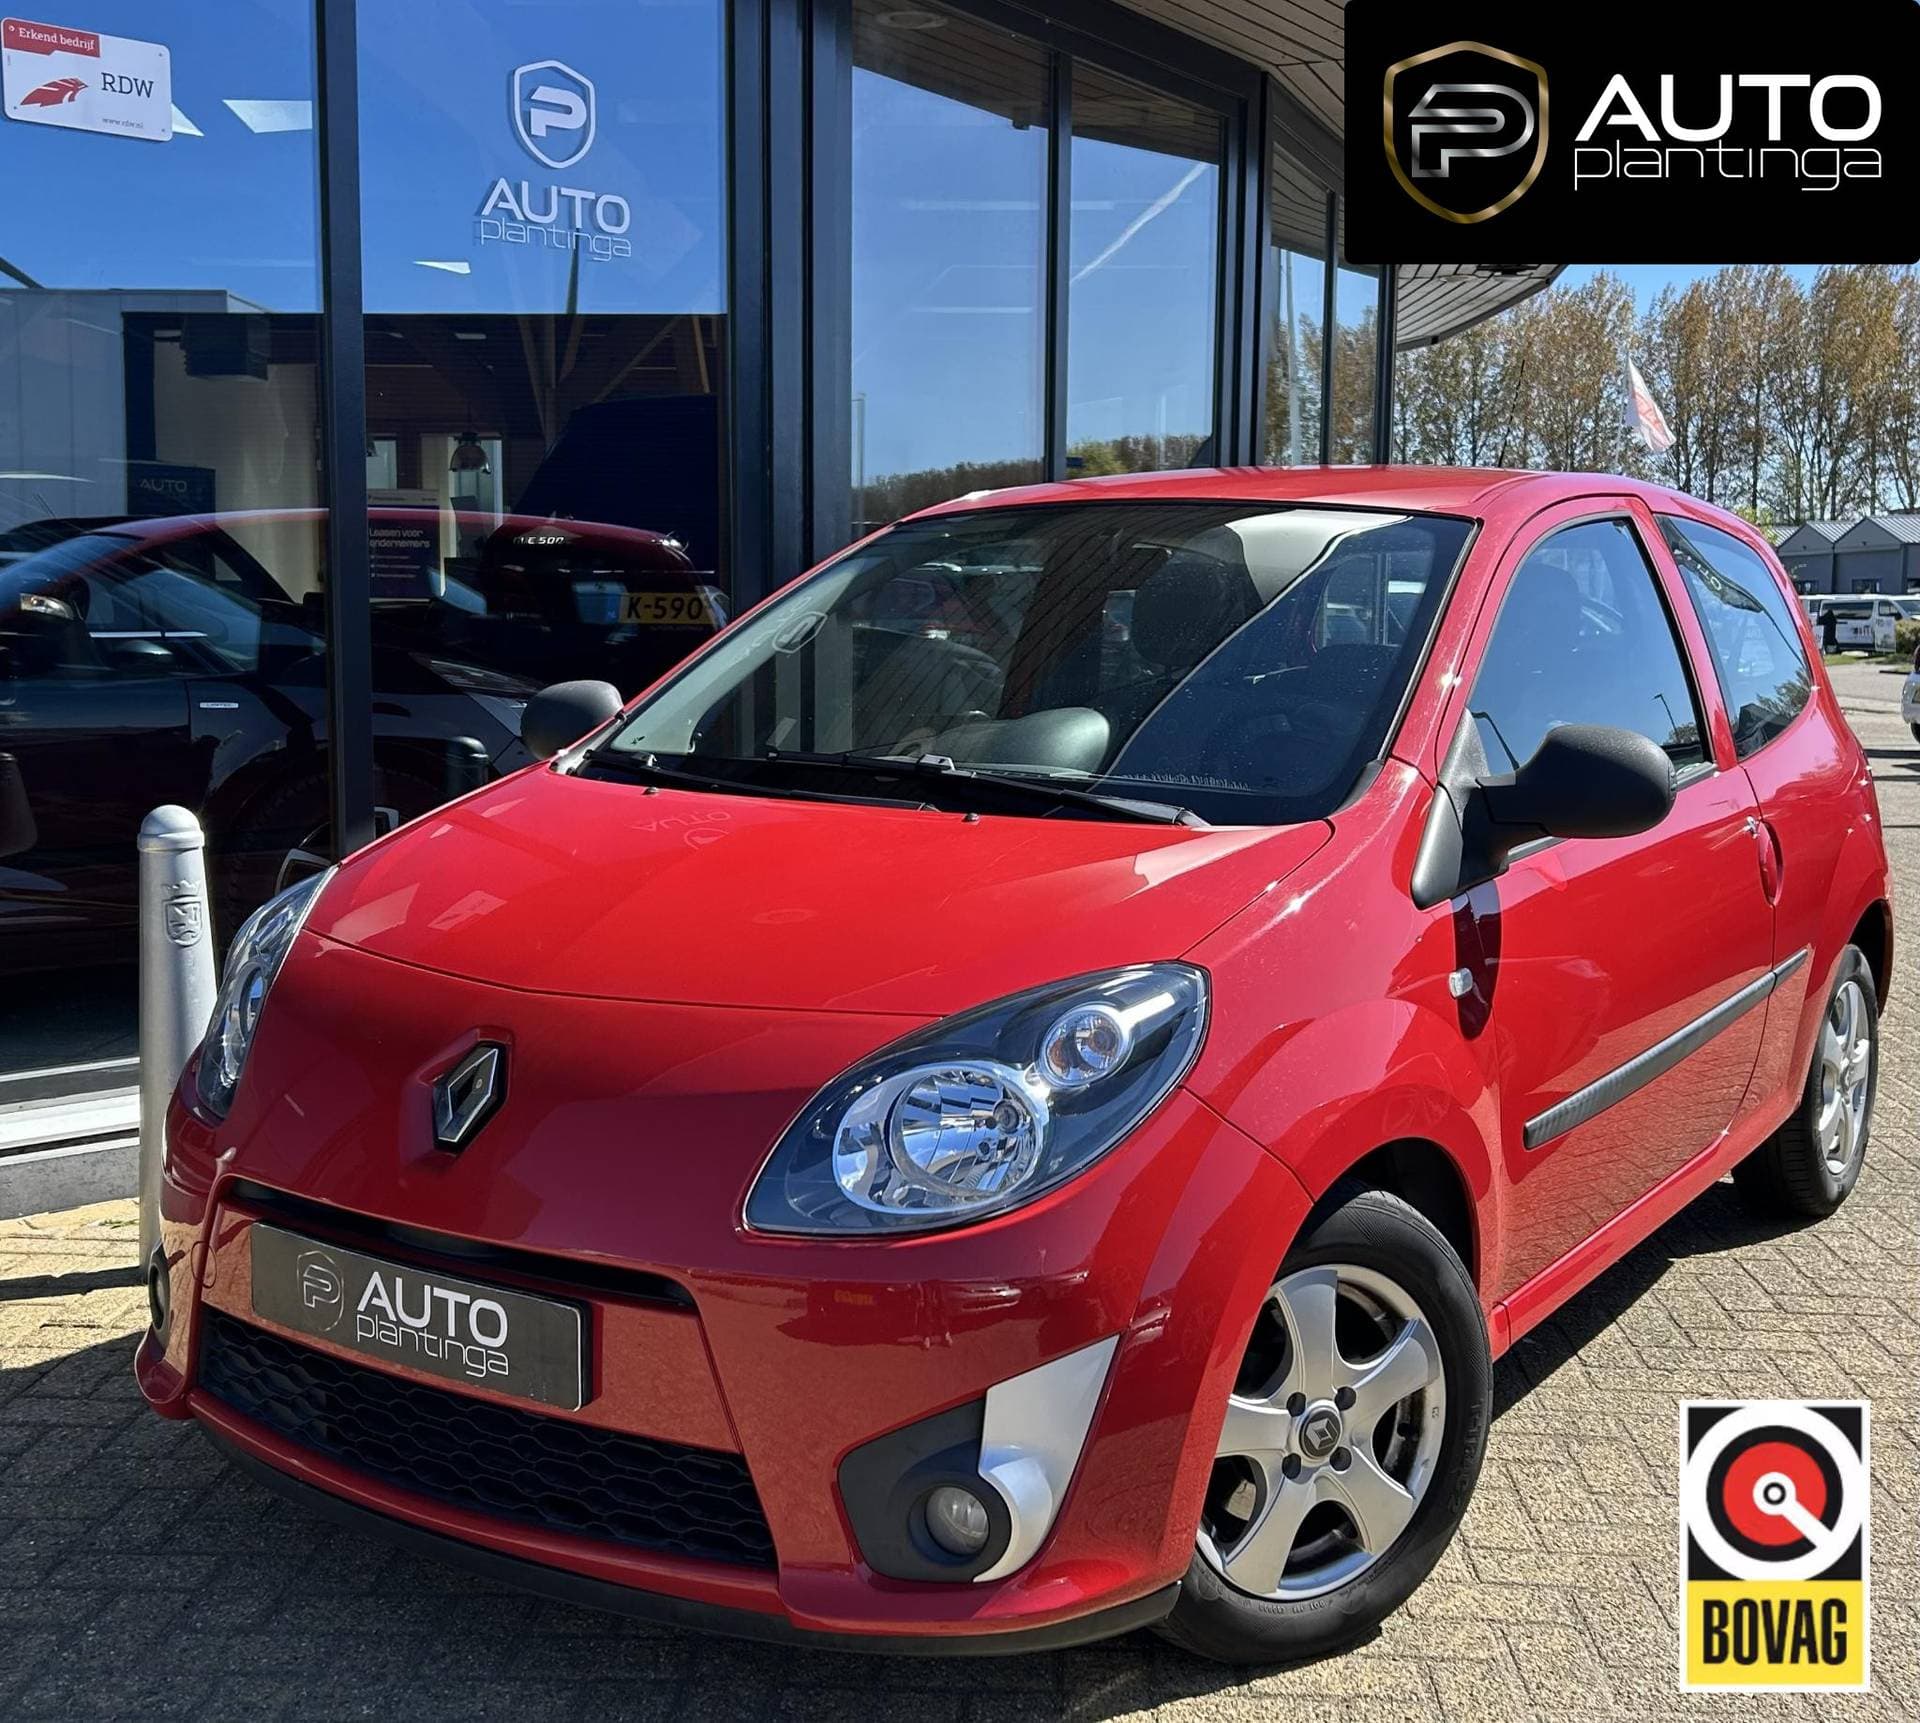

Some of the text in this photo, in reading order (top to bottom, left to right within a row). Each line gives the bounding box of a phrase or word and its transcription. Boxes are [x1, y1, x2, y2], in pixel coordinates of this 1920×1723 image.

[18, 27, 95, 51] Erkend bedrijf
[100, 72, 154, 99] RDW
[481, 177, 631, 234] AUTO
[480, 217, 632, 262] plantinga
[140, 478, 188, 493] AUTO
[356, 1271, 508, 1348] AUTO
[356, 1313, 509, 1378] plantinga
